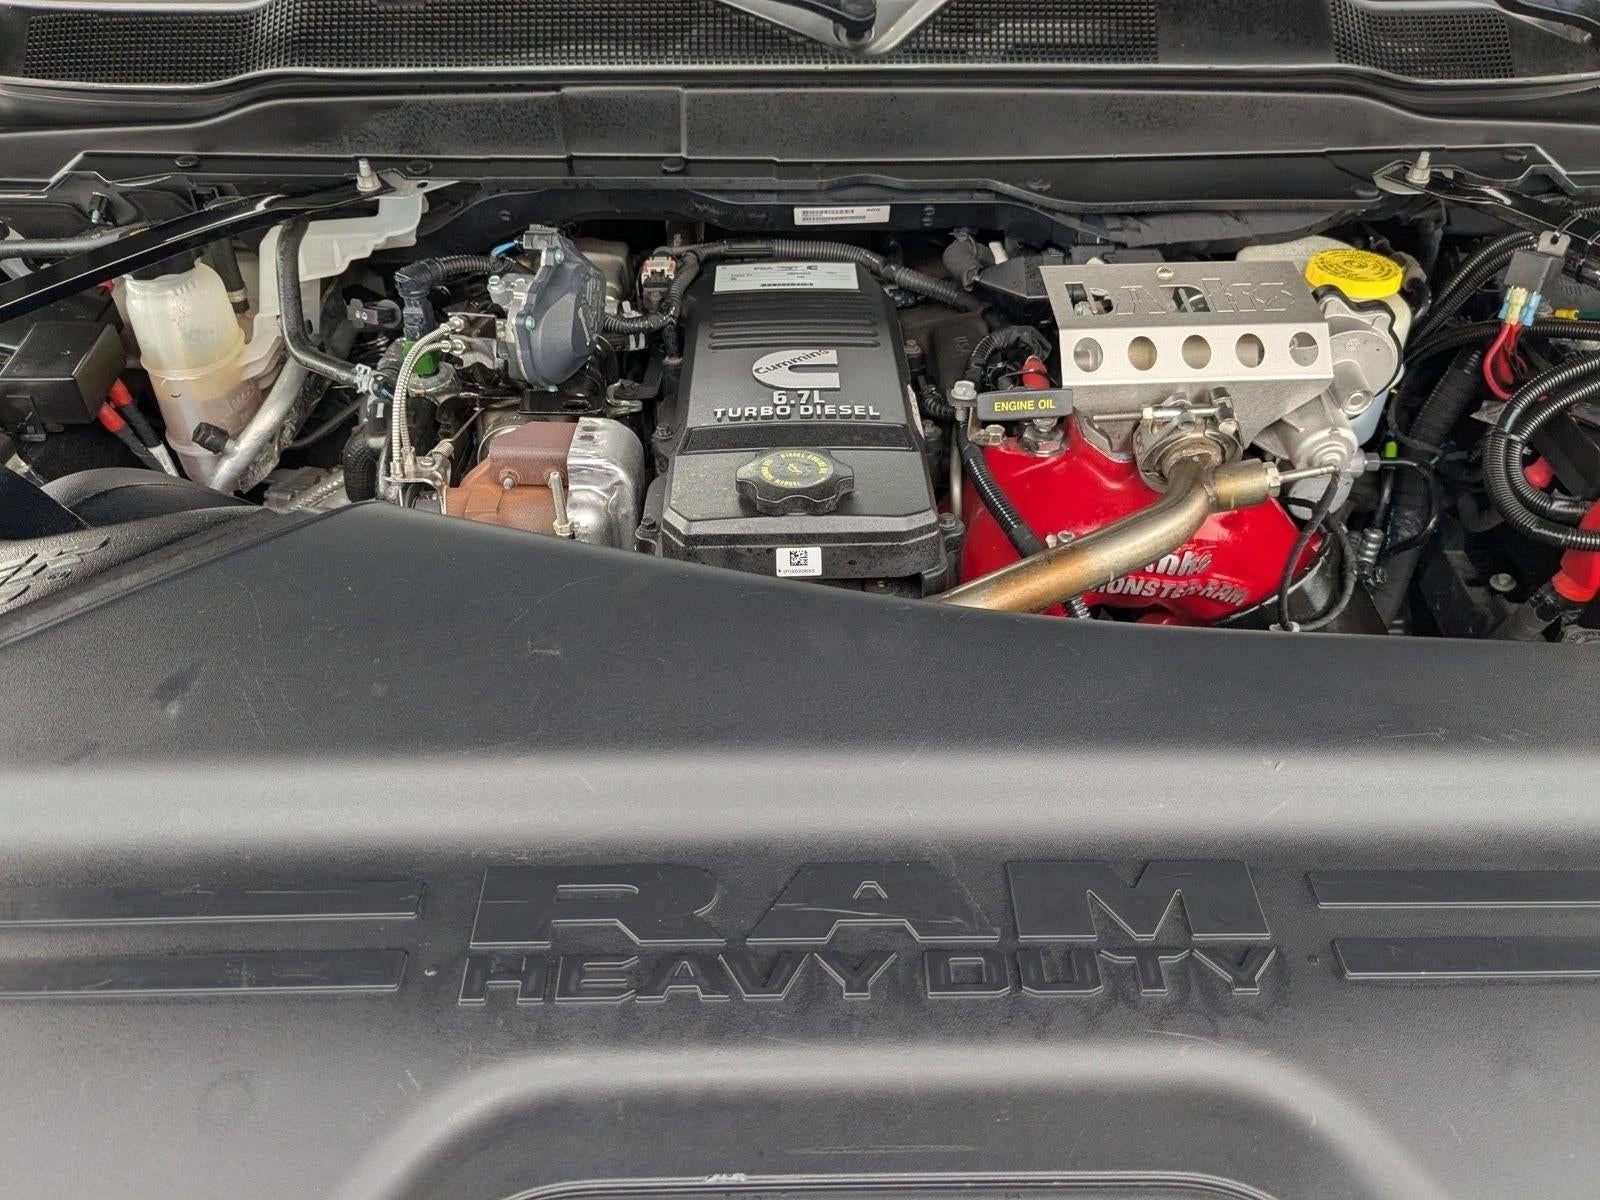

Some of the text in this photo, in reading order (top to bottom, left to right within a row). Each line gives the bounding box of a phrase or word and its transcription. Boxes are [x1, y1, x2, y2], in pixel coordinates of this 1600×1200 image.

[754, 349, 829, 374] Cummins
[773, 390, 826, 406] 6.7L
[994, 399, 1056, 412] ENGINE OIL
[714, 404, 881, 421] TURBO DIESEL
[774, 478, 802, 486] MANUAL
[470, 861, 1271, 948] RAM
[458, 948, 1276, 1005] HEAVY DUTY
